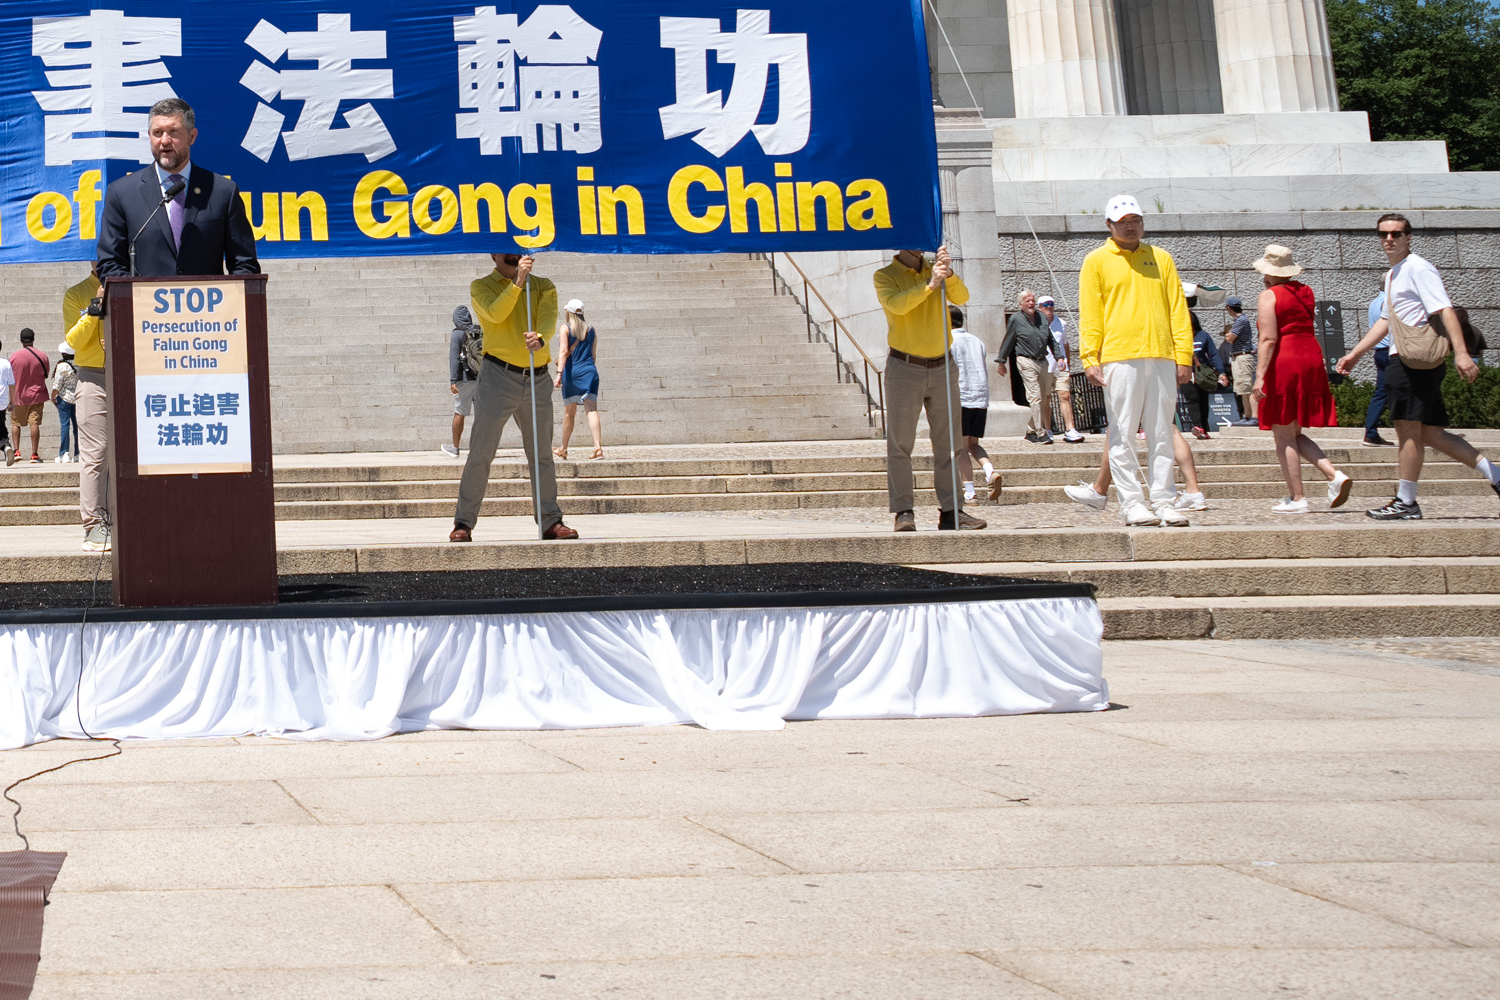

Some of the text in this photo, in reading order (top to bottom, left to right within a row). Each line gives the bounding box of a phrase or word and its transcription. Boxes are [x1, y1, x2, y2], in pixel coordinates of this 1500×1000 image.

[26, 169, 101, 243] of
[353, 170, 557, 248] Gong
[577, 165, 645, 236] in
[667, 162, 893, 236] China
[153, 287, 223, 313] STOP
[142, 318, 238, 333] Persecution of
[153, 337, 228, 352] Falun Gong
[164, 355, 218, 369] in China
[144, 392, 239, 417] 停止迫害
[157, 422, 228, 447] 法輪功
